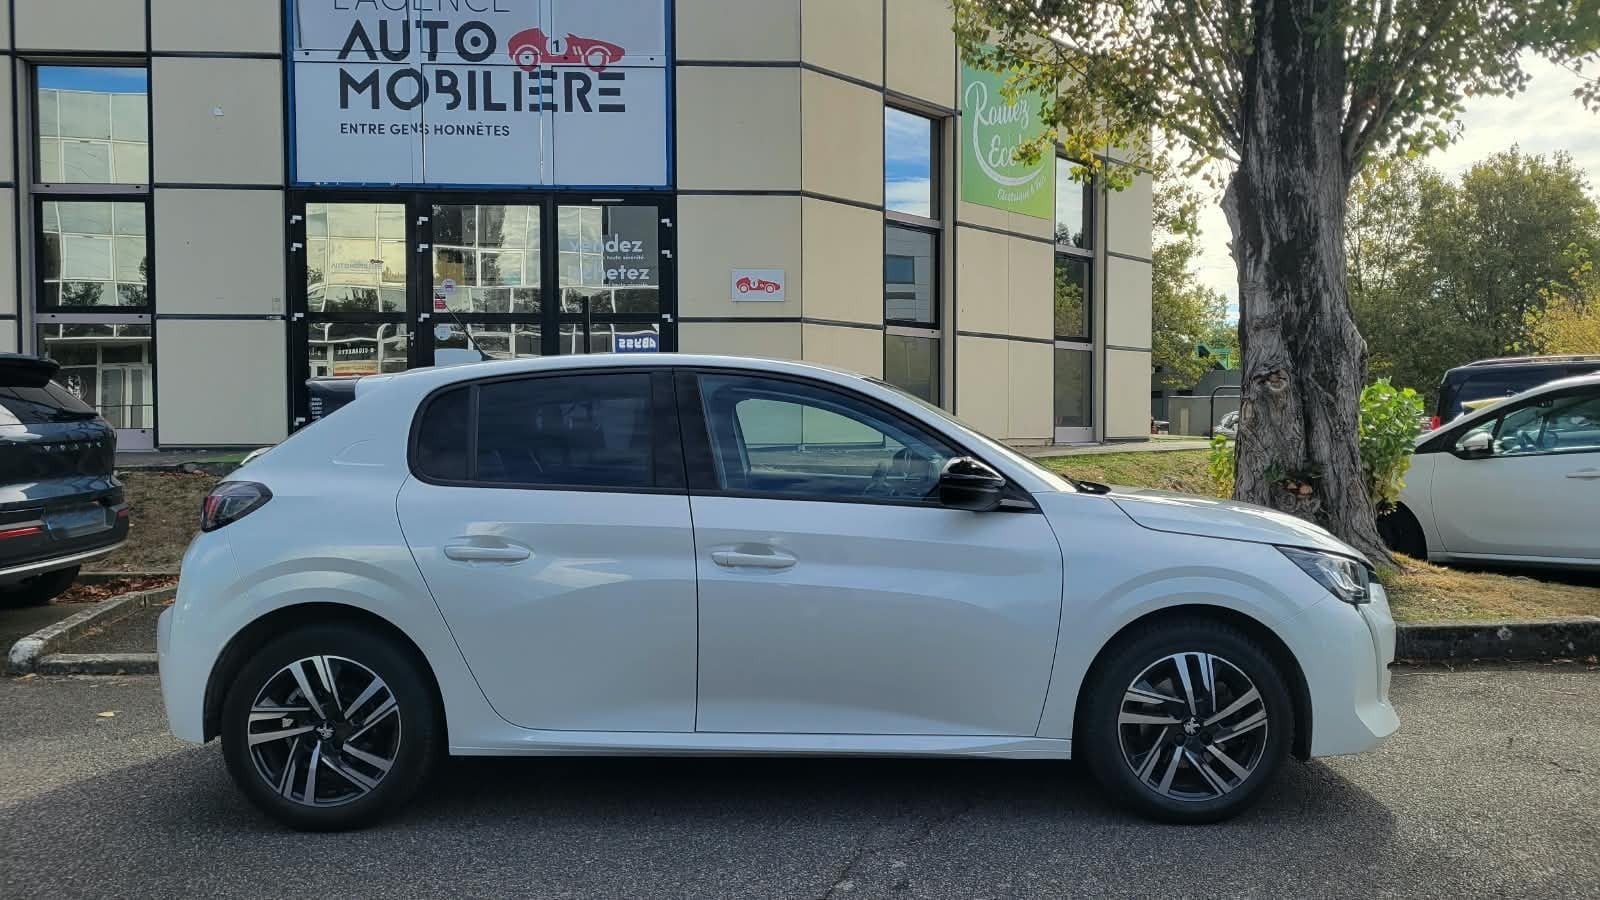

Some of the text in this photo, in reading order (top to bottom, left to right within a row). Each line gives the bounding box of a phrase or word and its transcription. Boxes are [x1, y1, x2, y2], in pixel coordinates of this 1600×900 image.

[337, 19, 497, 63] AUTO
[552, 39, 560, 53] 1
[340, 122, 510, 137] ENTRE GENS HONNÊTES
